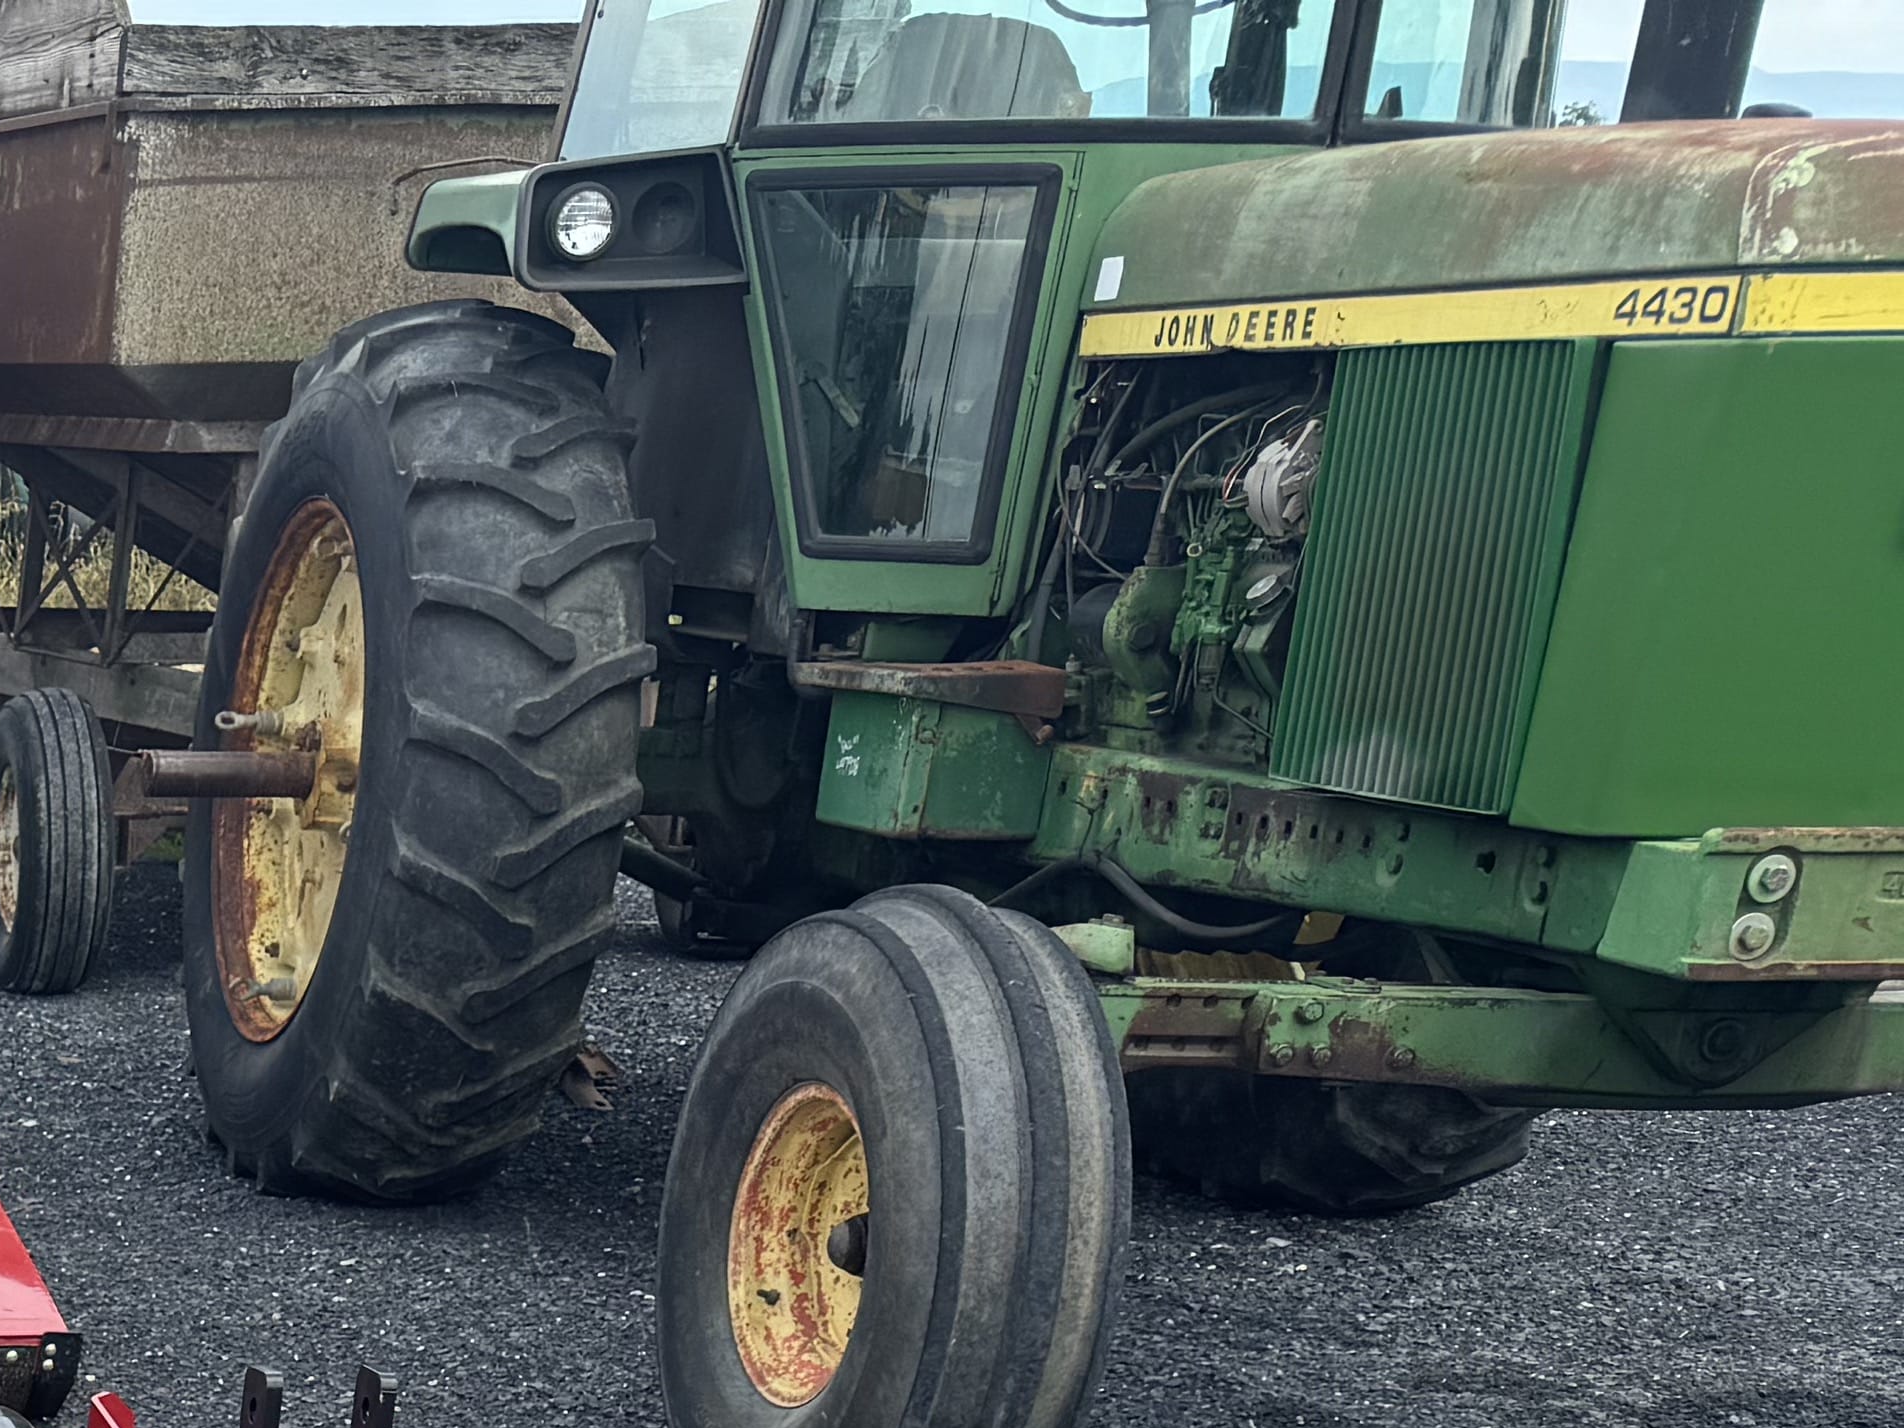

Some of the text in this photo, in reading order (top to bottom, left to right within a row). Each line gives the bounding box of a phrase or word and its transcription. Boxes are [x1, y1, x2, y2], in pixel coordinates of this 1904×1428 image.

[1612, 285, 1731, 326] 4430
[1154, 307, 1319, 347] JOHN DEERE
